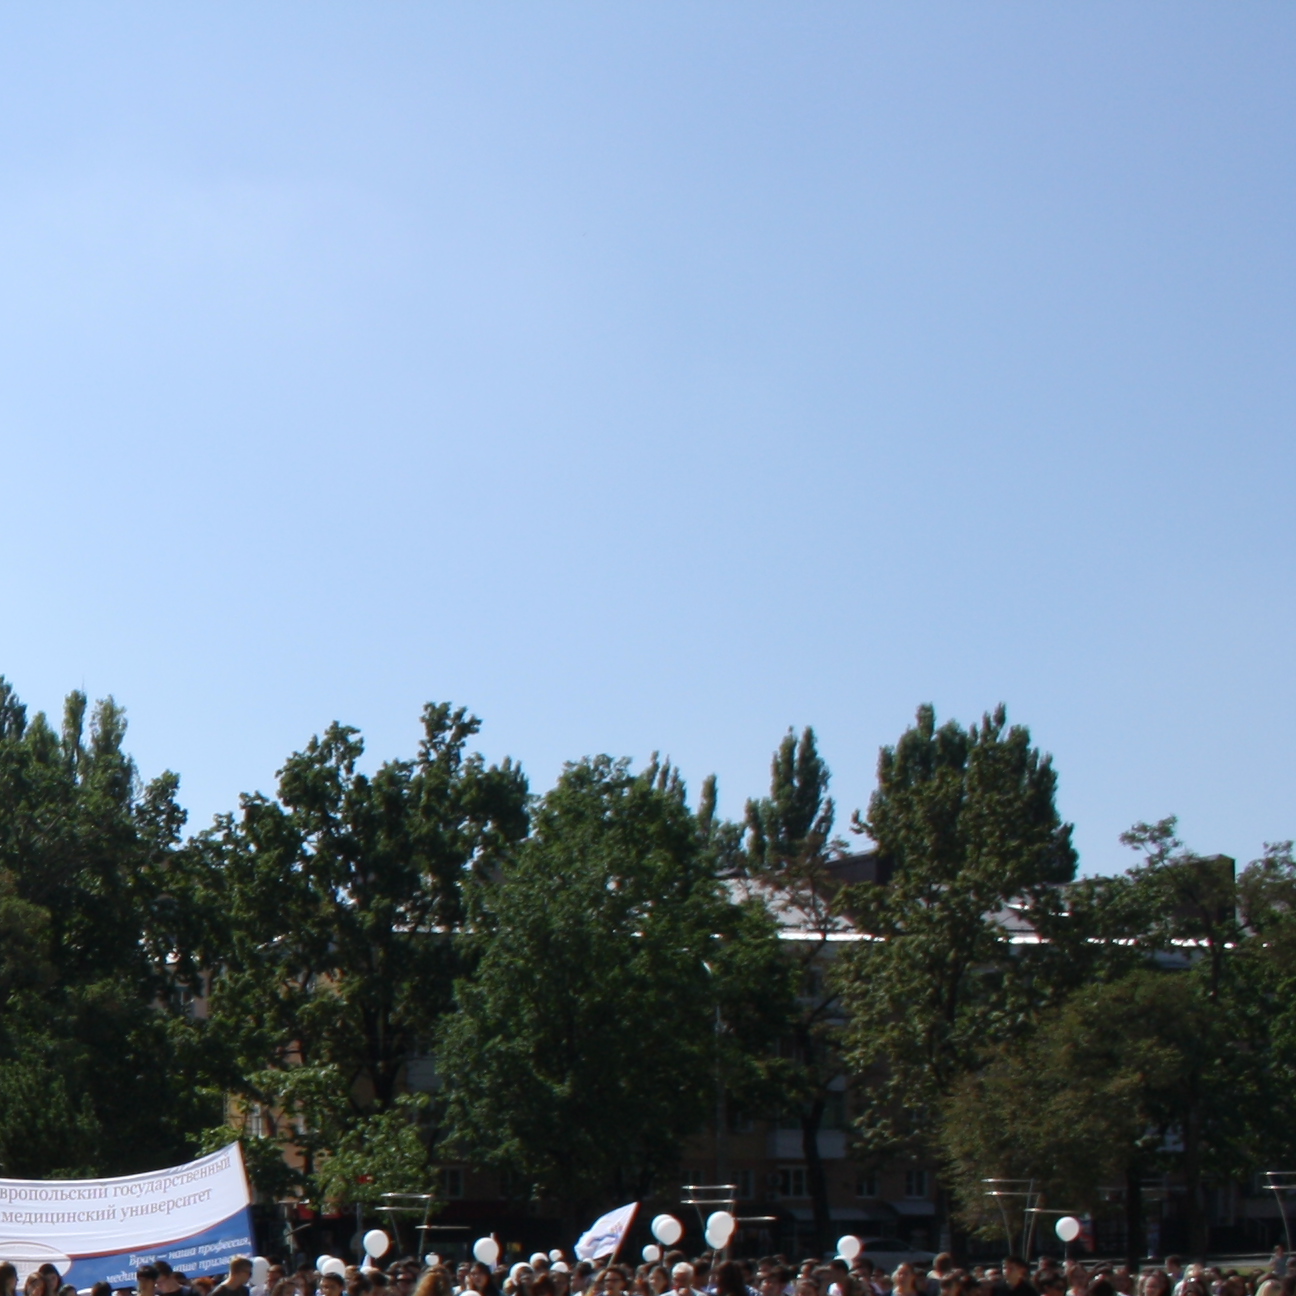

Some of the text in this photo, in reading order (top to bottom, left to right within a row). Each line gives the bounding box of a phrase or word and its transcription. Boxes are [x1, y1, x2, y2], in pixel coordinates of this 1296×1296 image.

[113, 1153, 232, 1198] государственный
[1, 1188, 212, 1225] медицинский университет
[129, 1254, 156, 1268] Врач
[169, 1247, 196, 1260] наша
